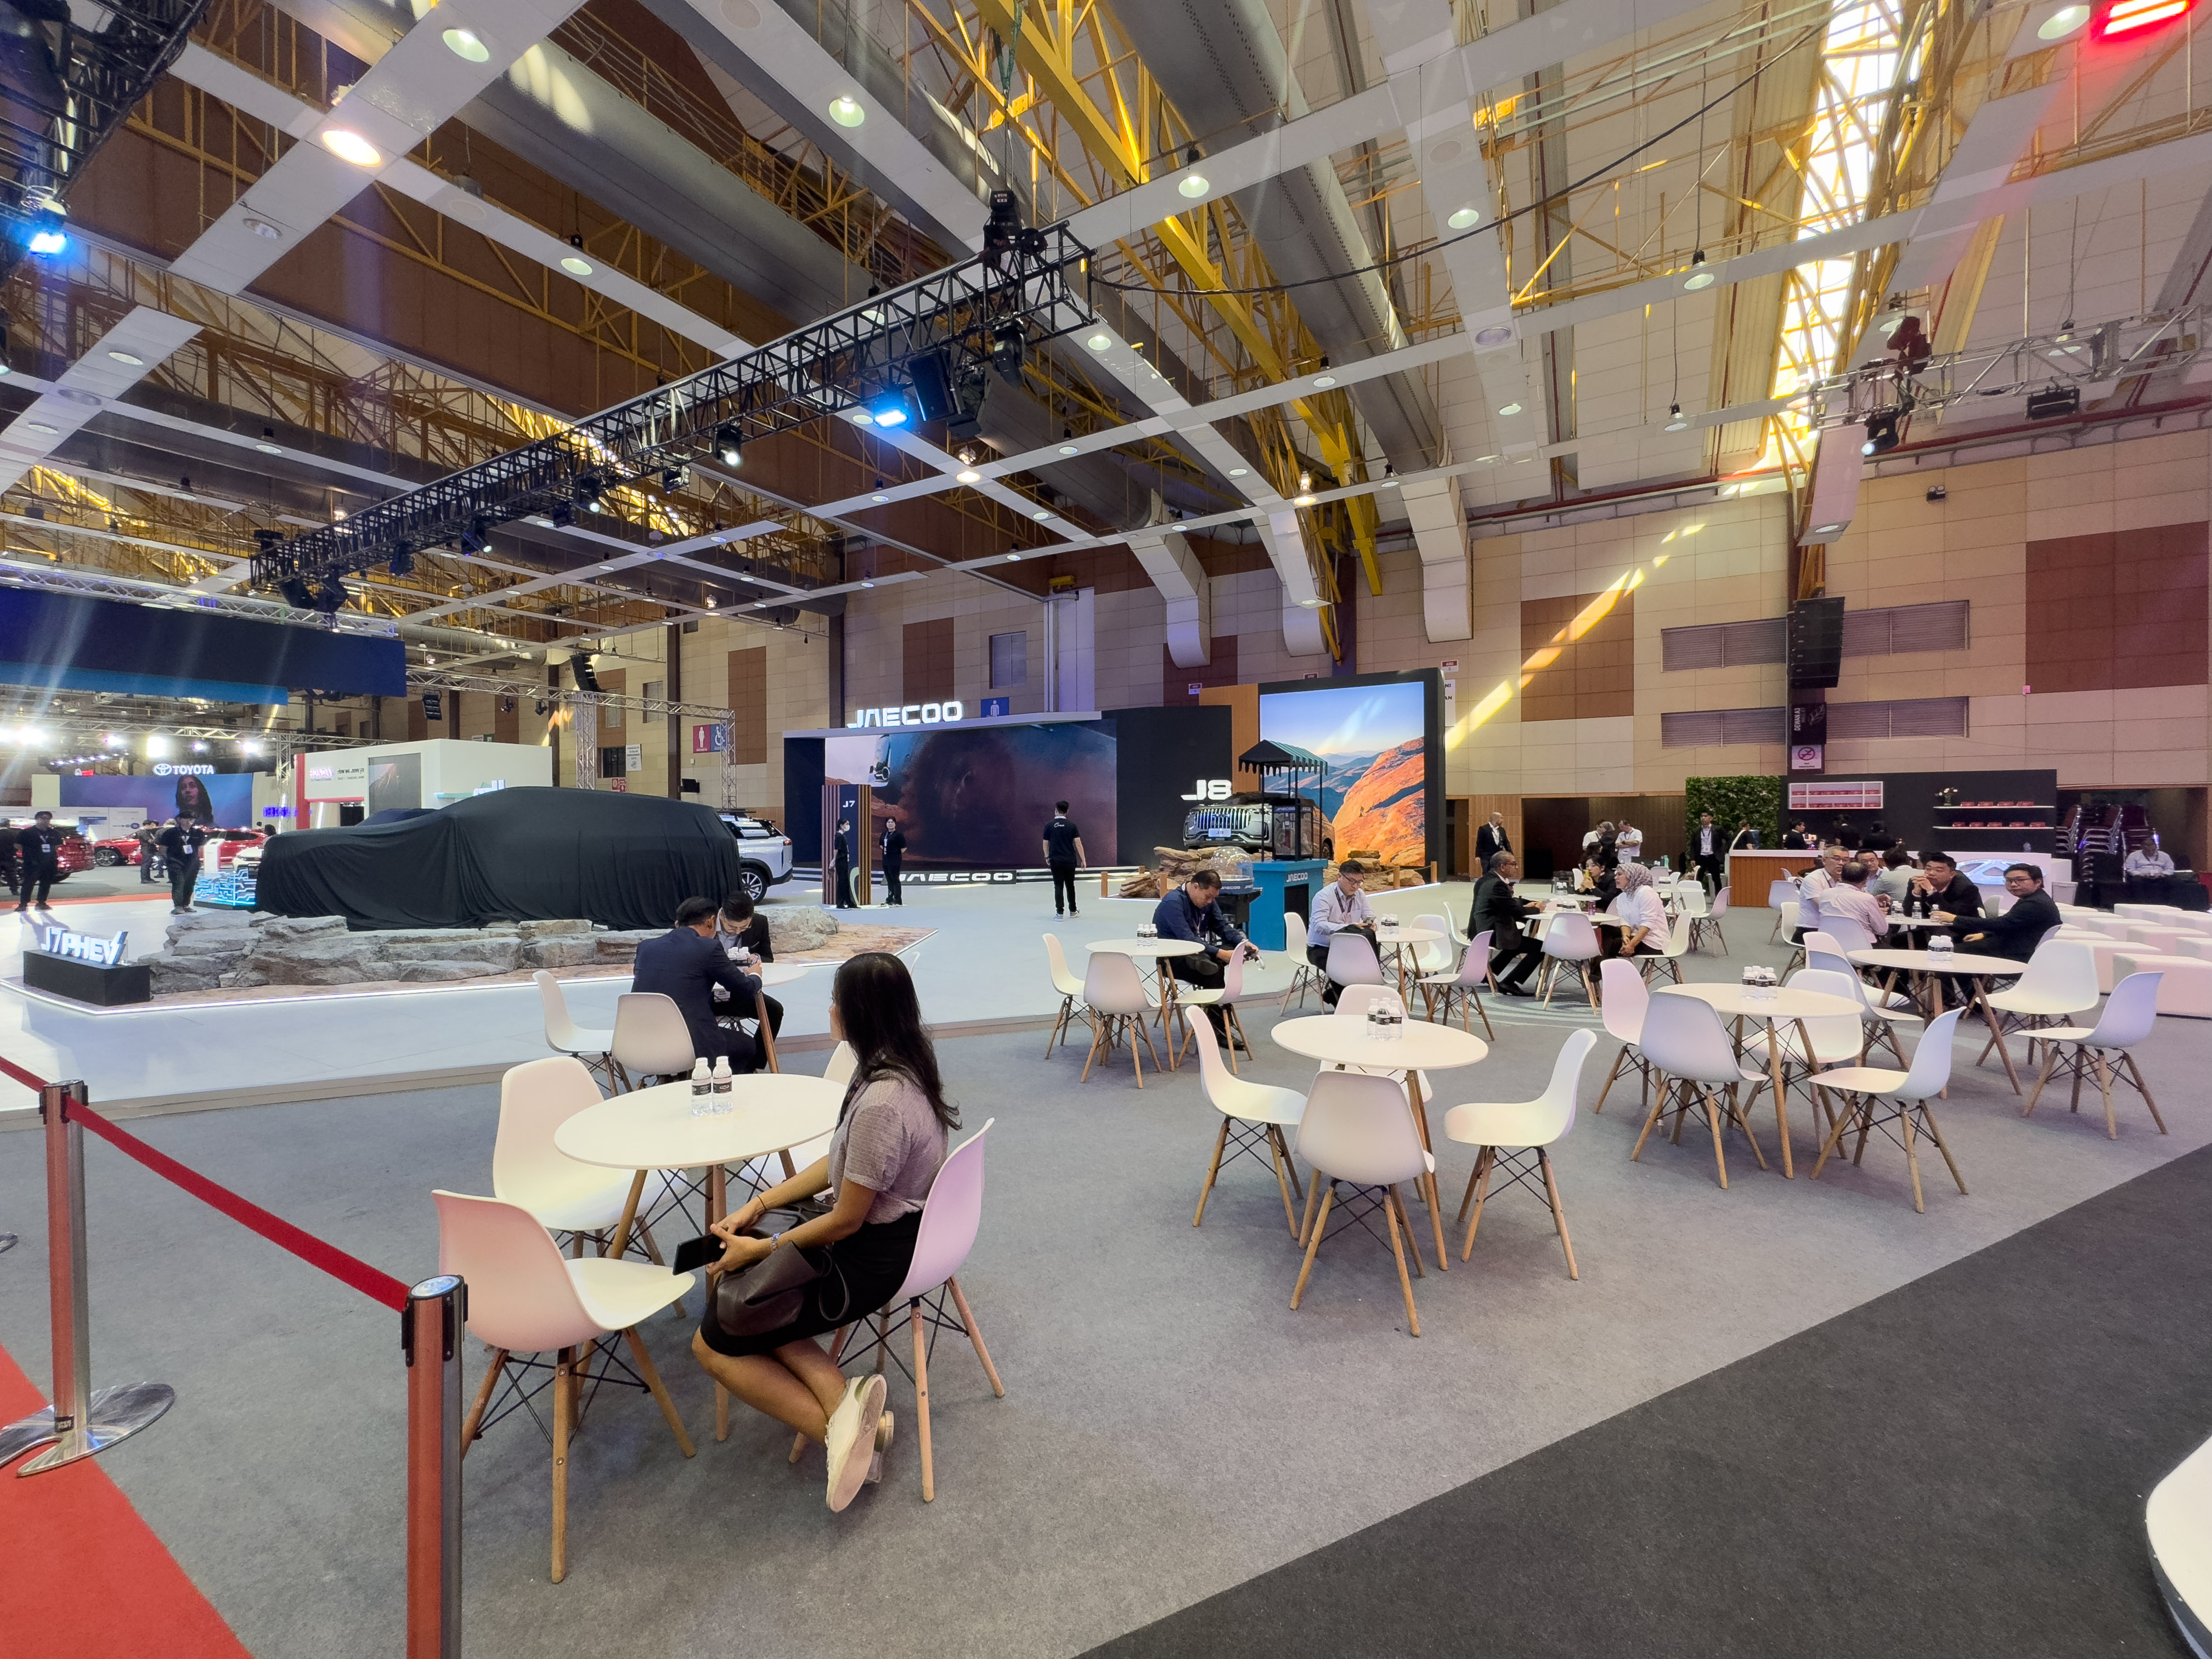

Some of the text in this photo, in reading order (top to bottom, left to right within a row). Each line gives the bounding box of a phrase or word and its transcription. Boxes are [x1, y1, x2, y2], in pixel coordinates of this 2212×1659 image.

[847, 701, 963, 729] JAECOO
[172, 764, 215, 775] TOYOTA
[1181, 780, 1232, 800] J8
[1286, 872, 1308, 883] JAECOO
